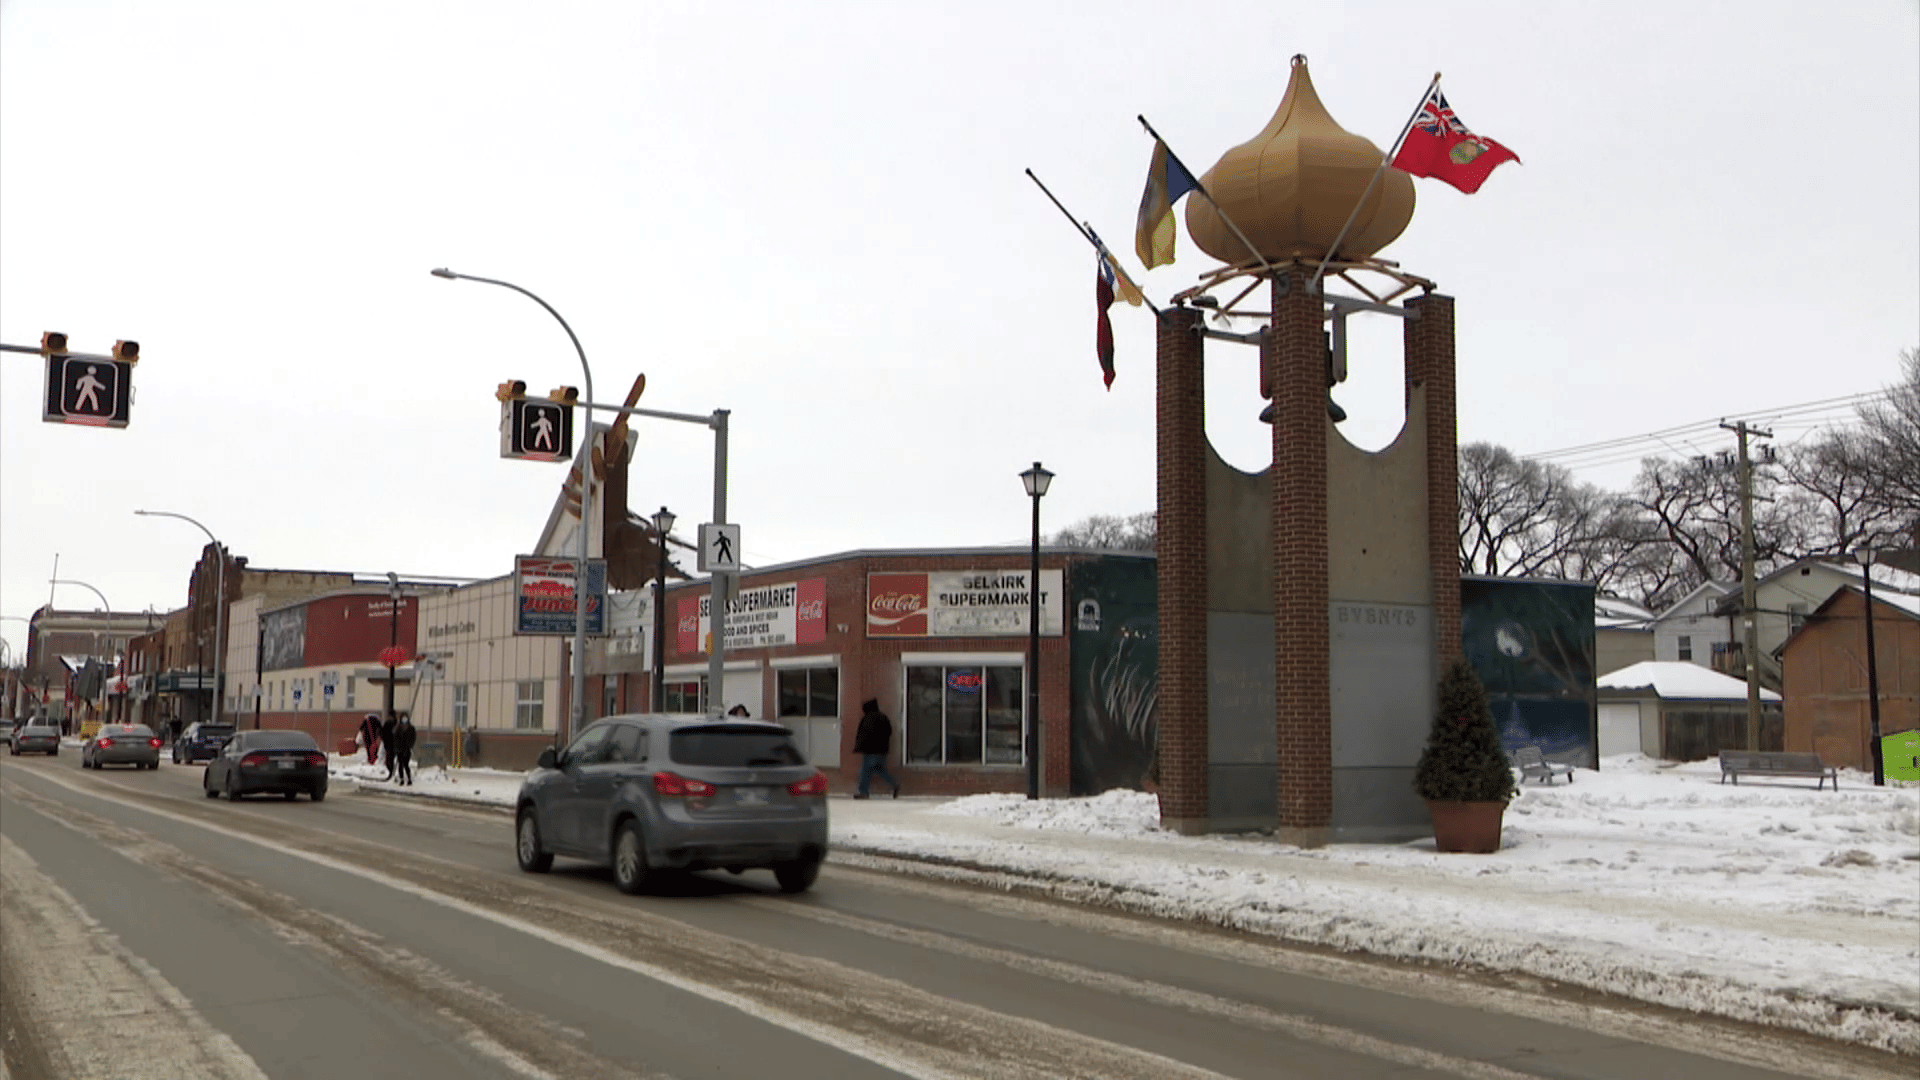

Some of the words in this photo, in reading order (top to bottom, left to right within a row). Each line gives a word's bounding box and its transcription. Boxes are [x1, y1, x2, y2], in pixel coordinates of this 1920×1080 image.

[963, 575, 1026, 590] SELKIRK
[732, 587, 797, 614] SUPERMARKET
[939, 591, 1049, 607] SUPERMARKT
[1336, 606, 1417, 627] EVENTS
[723, 627, 735, 637] OOD
[749, 623, 769, 635] SPICES
